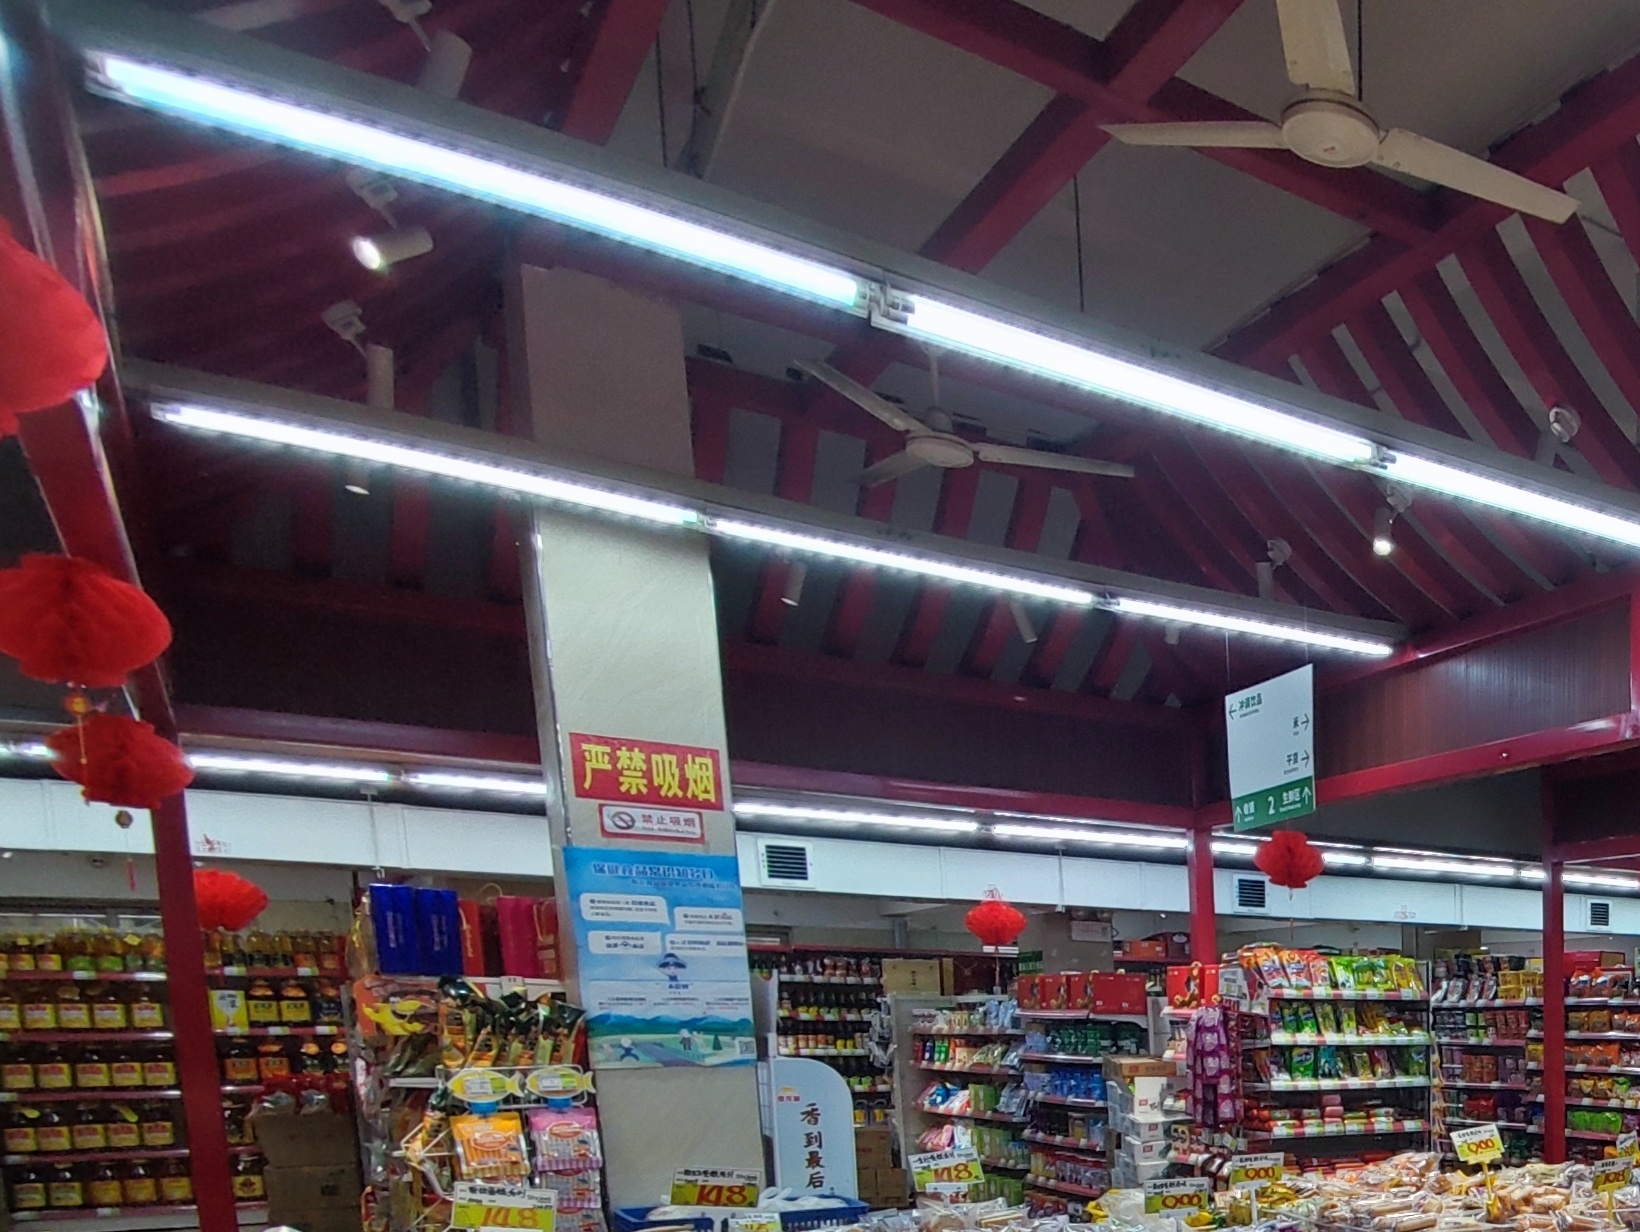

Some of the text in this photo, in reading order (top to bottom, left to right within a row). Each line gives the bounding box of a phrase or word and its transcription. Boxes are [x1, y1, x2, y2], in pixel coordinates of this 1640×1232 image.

[581, 743, 716, 803] 严禁吸烟
[641, 814, 696, 827] 禁止吸烟
[1267, 796, 1275, 815] 2
[800, 1102, 825, 1189] 香到最后
